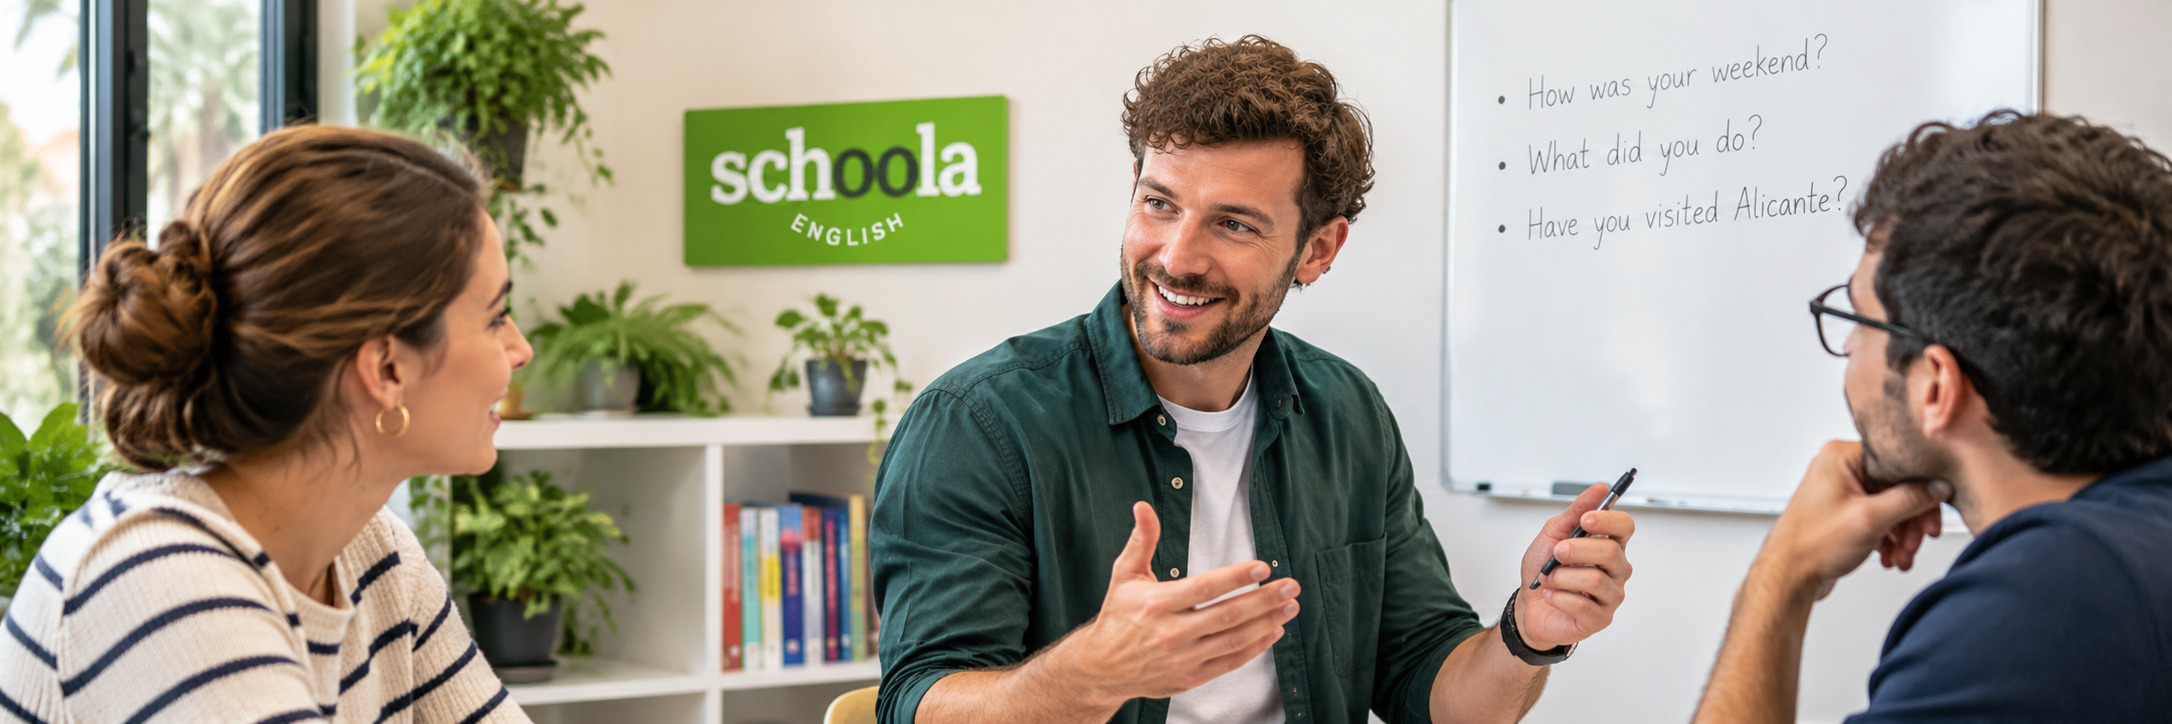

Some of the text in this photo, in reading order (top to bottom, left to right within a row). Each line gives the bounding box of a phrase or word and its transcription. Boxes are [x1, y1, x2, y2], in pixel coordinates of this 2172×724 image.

[1528, 33, 1828, 110] How was your weekend?
[710, 121, 982, 205] schoola
[1528, 114, 1762, 176] What did you do?
[791, 212, 904, 246] ENGLISH
[1528, 175, 1848, 250] Have you visited Alicante?
